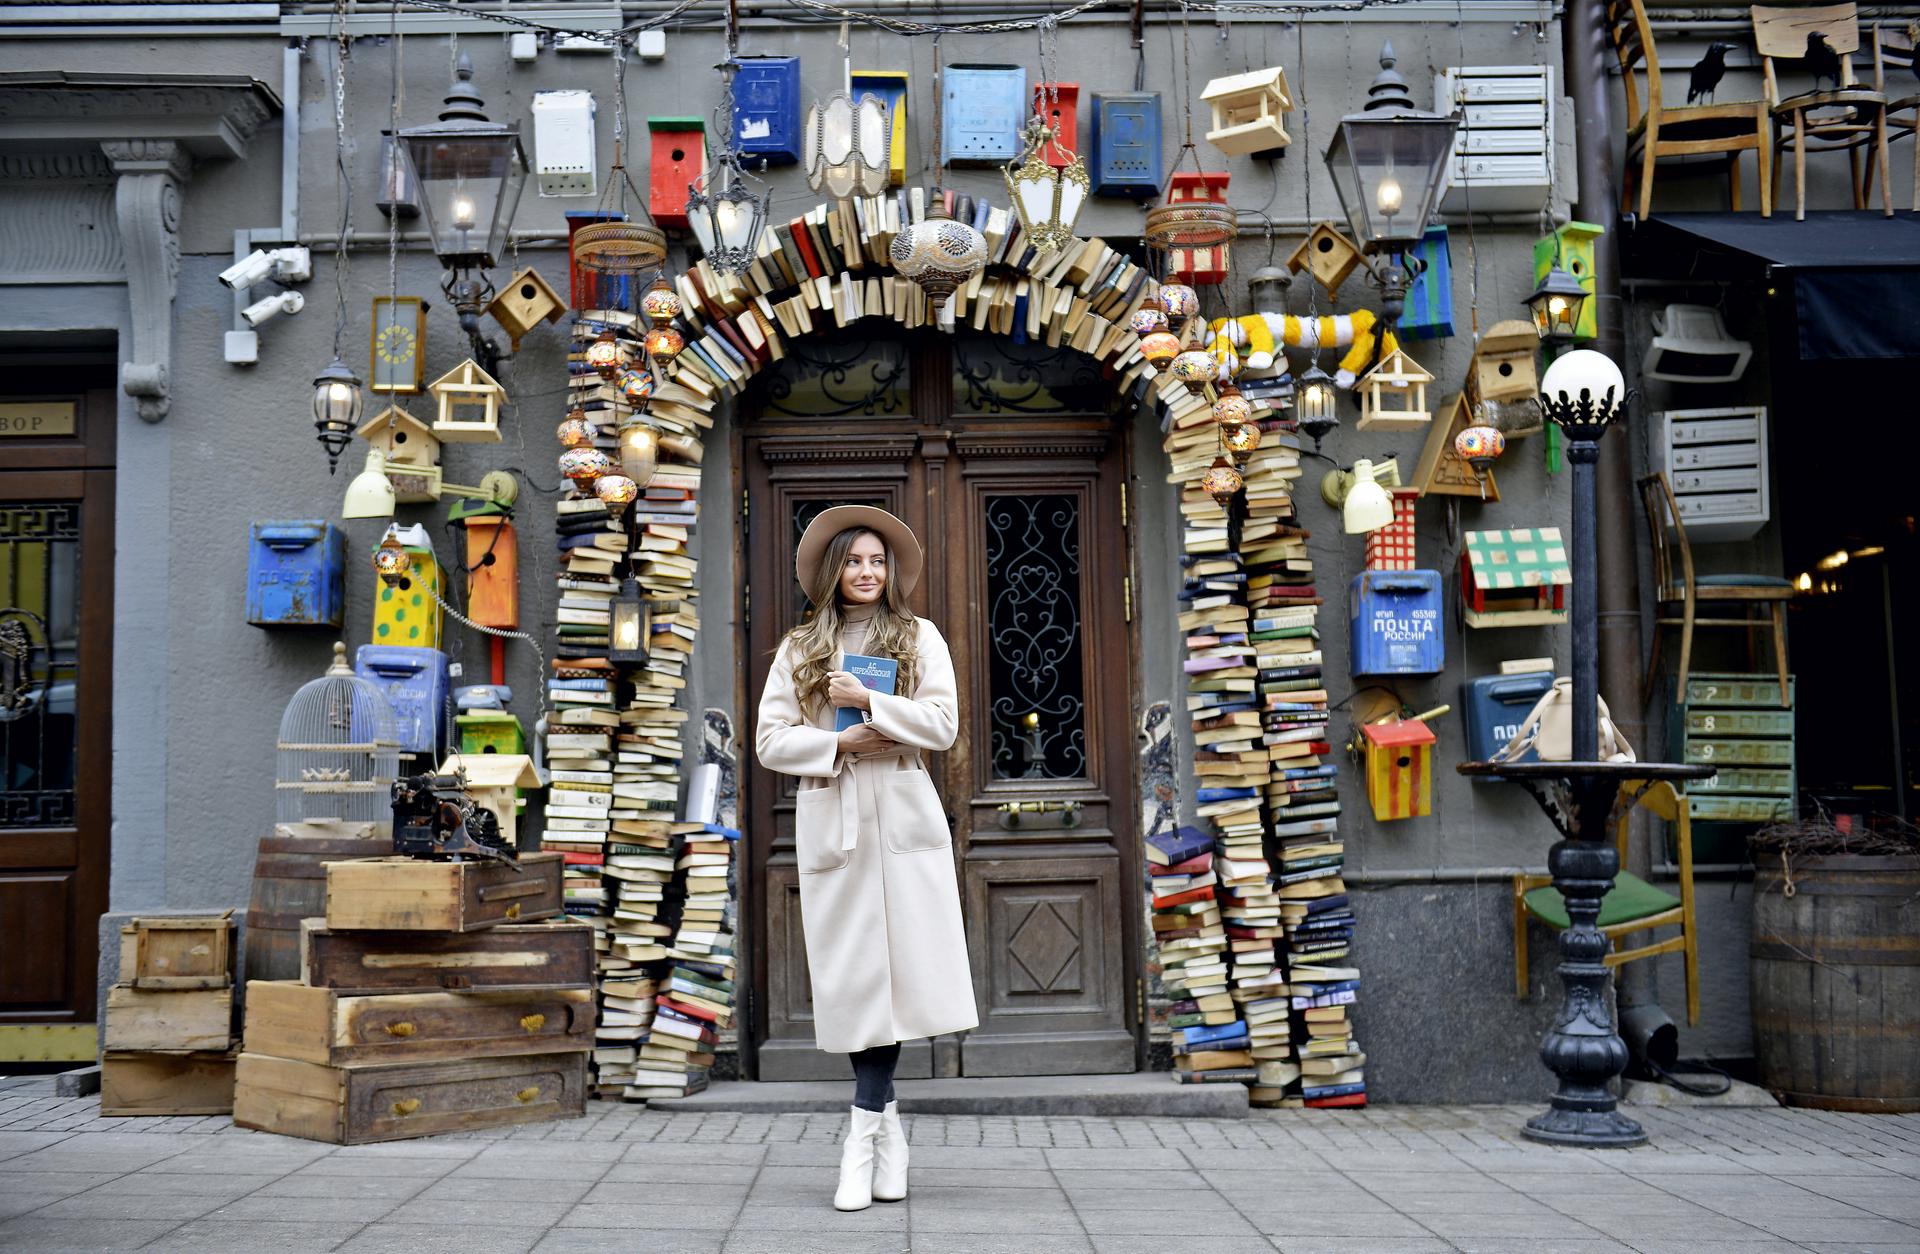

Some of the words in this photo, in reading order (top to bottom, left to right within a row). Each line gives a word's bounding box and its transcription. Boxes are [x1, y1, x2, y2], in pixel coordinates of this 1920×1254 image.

[1374, 619, 1433, 632] ПОЧТА
[1384, 631, 1426, 641] РОССИИ
[1704, 716, 1716, 732] 8
[1703, 745, 1714, 760] 9
[1704, 775, 1719, 789] 10
